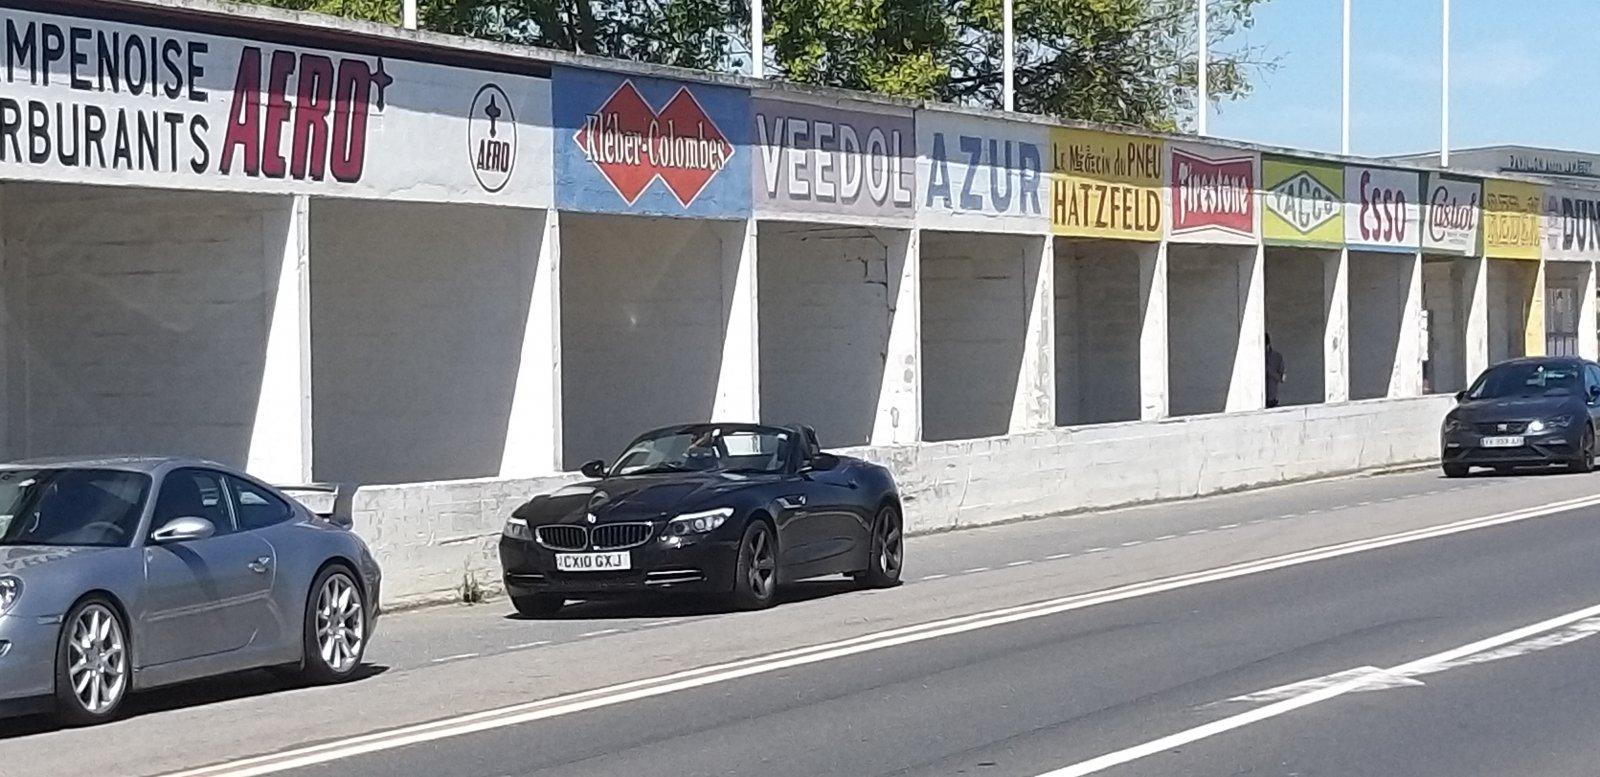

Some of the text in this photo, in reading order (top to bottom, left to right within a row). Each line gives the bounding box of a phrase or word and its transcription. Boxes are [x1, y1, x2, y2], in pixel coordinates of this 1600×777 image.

[0, 18, 209, 101] MPENOISE
[0, 98, 210, 174] RBURANTS
[219, 46, 371, 184] AERO
[476, 138, 510, 173] AERO
[757, 113, 913, 207] VEEDOL
[925, 132, 1041, 215] AZUR
[1114, 147, 1126, 176] du
[1127, 142, 1161, 179] PNEU
[1053, 180, 1161, 232] HATZFELD
[1178, 162, 1249, 224] Firestone
[1429, 186, 1477, 242] Castrol
[564, 554, 622, 568] CX10 GXJ
